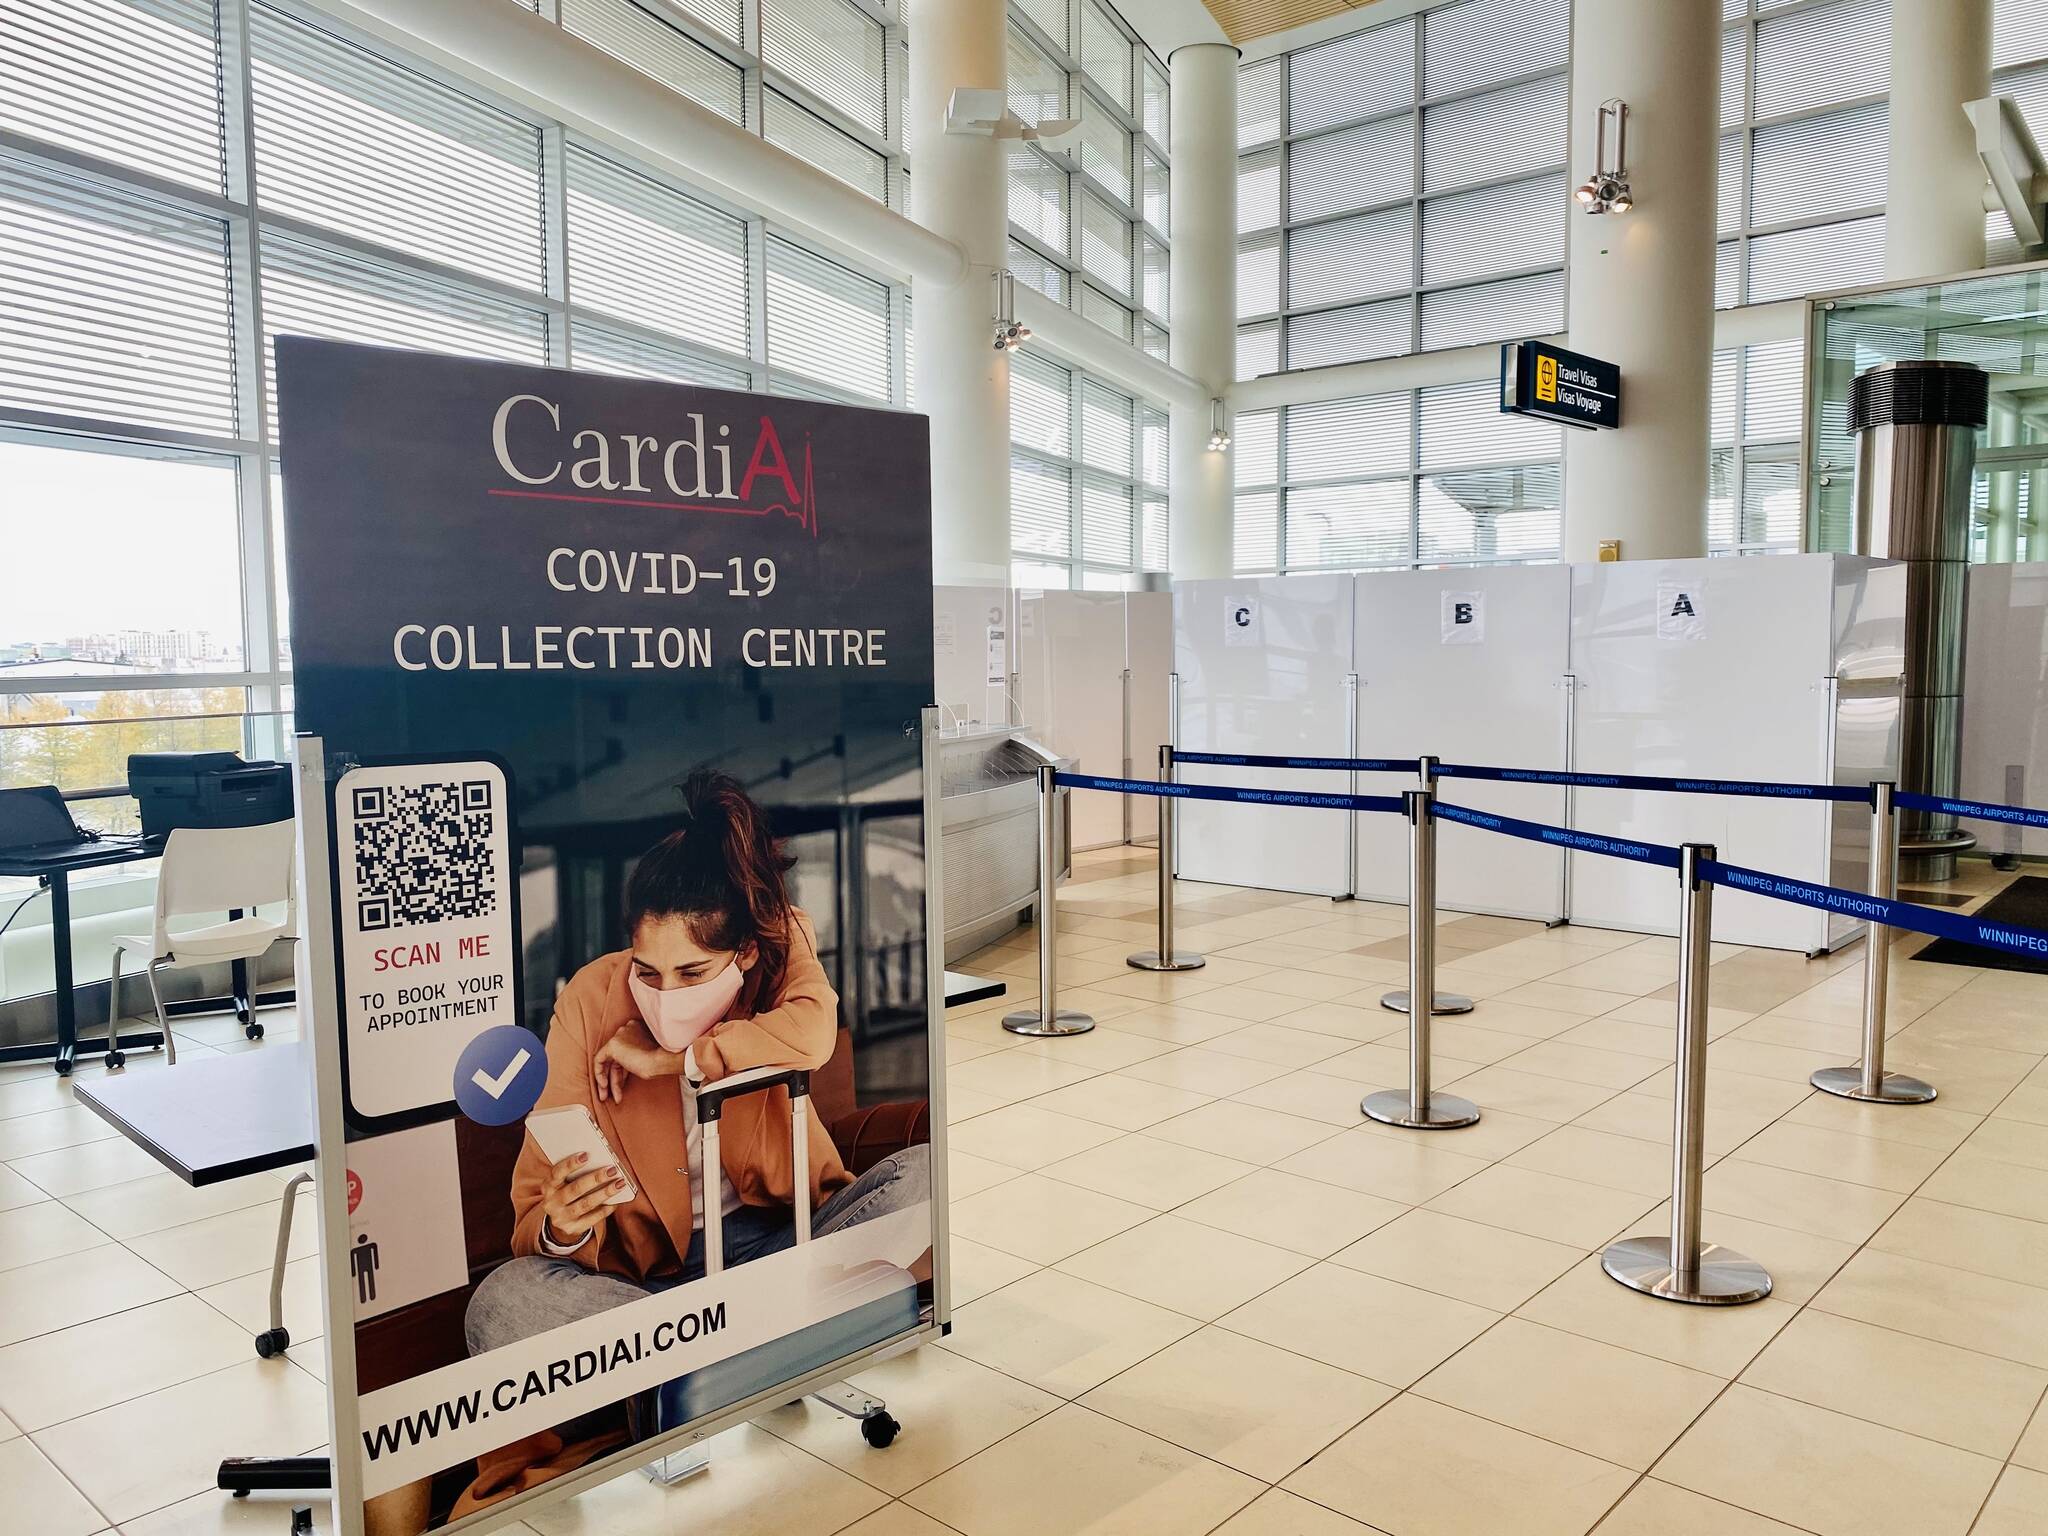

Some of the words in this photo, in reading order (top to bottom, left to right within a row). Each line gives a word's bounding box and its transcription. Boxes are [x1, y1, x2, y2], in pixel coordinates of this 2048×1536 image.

[1558, 364, 1579, 382] Travel
[1580, 369, 1597, 387] Visas
[1557, 387, 1575, 405] Visas
[1576, 392, 1601, 414] Voyage
[546, 547, 776, 597] COVID-19
[1455, 603, 1473, 624] B
[1671, 594, 1695, 617] A
[1235, 608, 1251, 627] C
[393, 624, 713, 671] COLLECTION
[742, 628, 886, 667] CENTRE
[1288, 759, 1317, 767] WINNIPEG
[1094, 780, 1122, 789] WINNIPEG
[1124, 783, 1154, 792] AIRPORTS
[1155, 786, 1190, 795] AUTHORITY
[1501, 771, 1537, 780] WINNIPEG
[1539, 773, 1574, 782] AIRPORTS
[1576, 775, 1619, 785] AUTHORITY
[1676, 781, 1716, 791] WINNIPEG
[1719, 783, 1761, 793] AIRPORTS
[1763, 786, 1813, 796] AUTHORITY
[1237, 791, 1271, 801] WINNIPEG
[1273, 795, 1308, 803] AIRPORTS
[1310, 797, 1352, 807] AUTHORITY
[1445, 808, 1470, 820] AIRPORTS
[1471, 815, 1502, 828] AUTHORITY
[1942, 802, 1981, 814] WINNIPEG
[1983, 808, 2024, 820] AIRPORTS
[1542, 829, 1574, 844] WINNIPEG
[1575, 836, 1608, 850] AIRPORTS
[1609, 843, 1650, 858] AUTHORITY
[1727, 871, 1773, 891] WINNIPEG
[1774, 882, 1824, 903] AIRPORTS
[1827, 894, 1889, 918] AUTHORITY
[1978, 926, 2048, 952] WINNIPEG
[374, 942, 441, 972] SCAN
[459, 935, 490, 959] ME
[360, 992, 384, 1011] TO
[398, 982, 446, 1006] BOOK
[458, 974, 504, 995] YOUR
[367, 995, 499, 1033] APPOINTMENT
[362, 1301, 726, 1461] WWW.CARDIAI.COM
